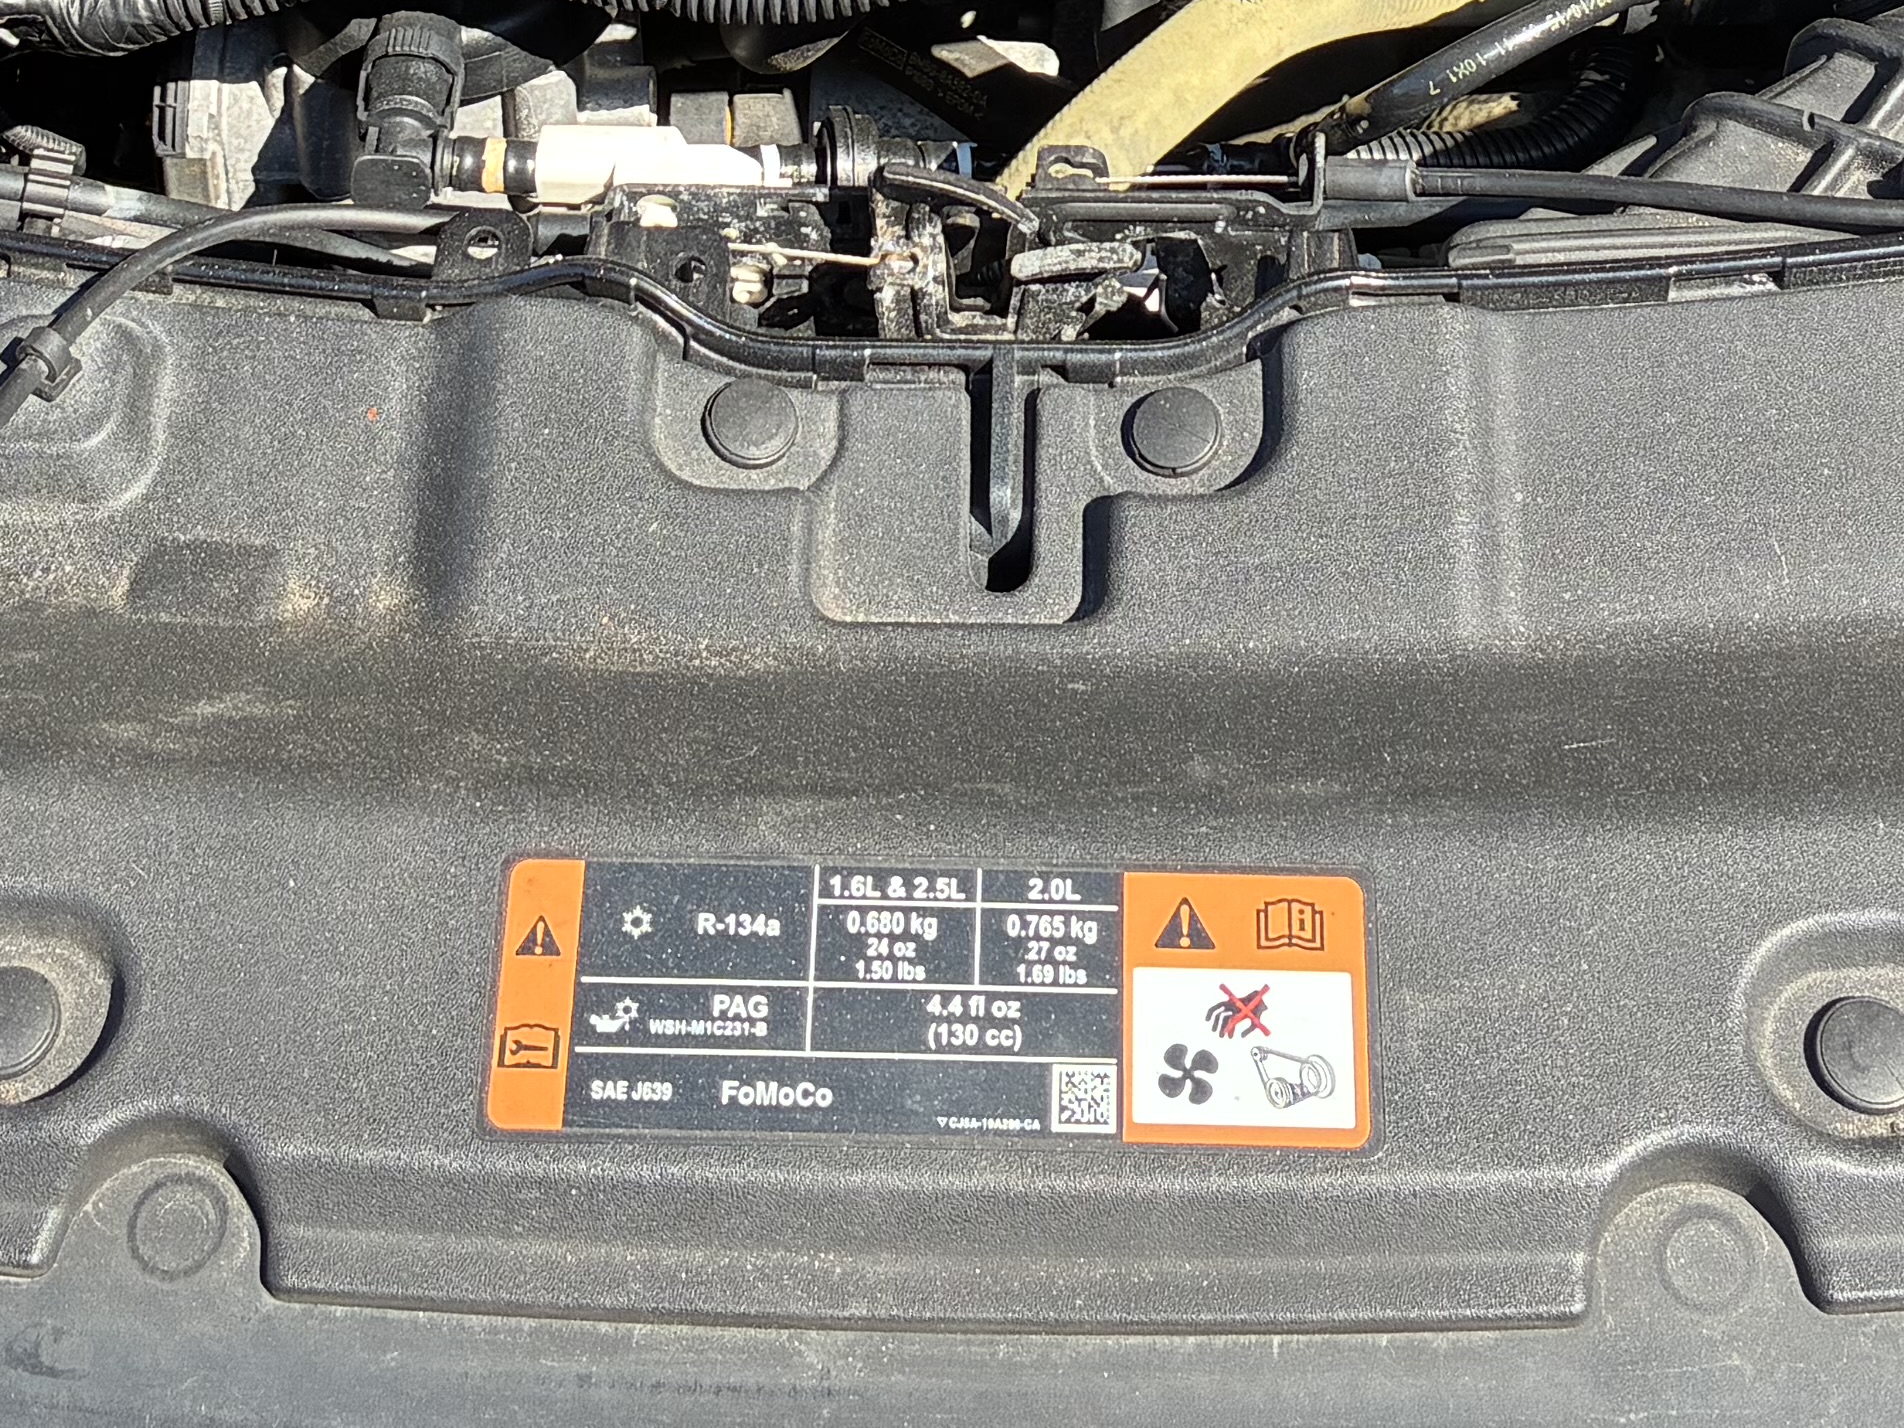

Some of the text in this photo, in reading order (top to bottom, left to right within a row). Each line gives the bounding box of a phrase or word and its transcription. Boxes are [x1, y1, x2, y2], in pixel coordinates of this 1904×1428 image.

[829, 874, 967, 900] 1.6L & 2.5L
[1027, 877, 1082, 902] 2.0L
[696, 911, 782, 937] R-134a
[846, 910, 939, 941] 0.680 kg
[1006, 913, 1099, 945] 0.765 kg
[866, 937, 917, 959] 24 oz
[1053, 944, 1078, 962] oz
[855, 959, 927, 982] 1.50 lbs
[1016, 963, 1089, 985] 1.69 lbs
[712, 993, 770, 1019] PAG
[925, 993, 1022, 1019] 4.4 fl oz
[648, 1017, 769, 1038] WSH-M1C231-B
[927, 1021, 1023, 1053] (130 cc)
[589, 1079, 674, 1102] SAE J639
[720, 1080, 834, 1108] FoMoCo
